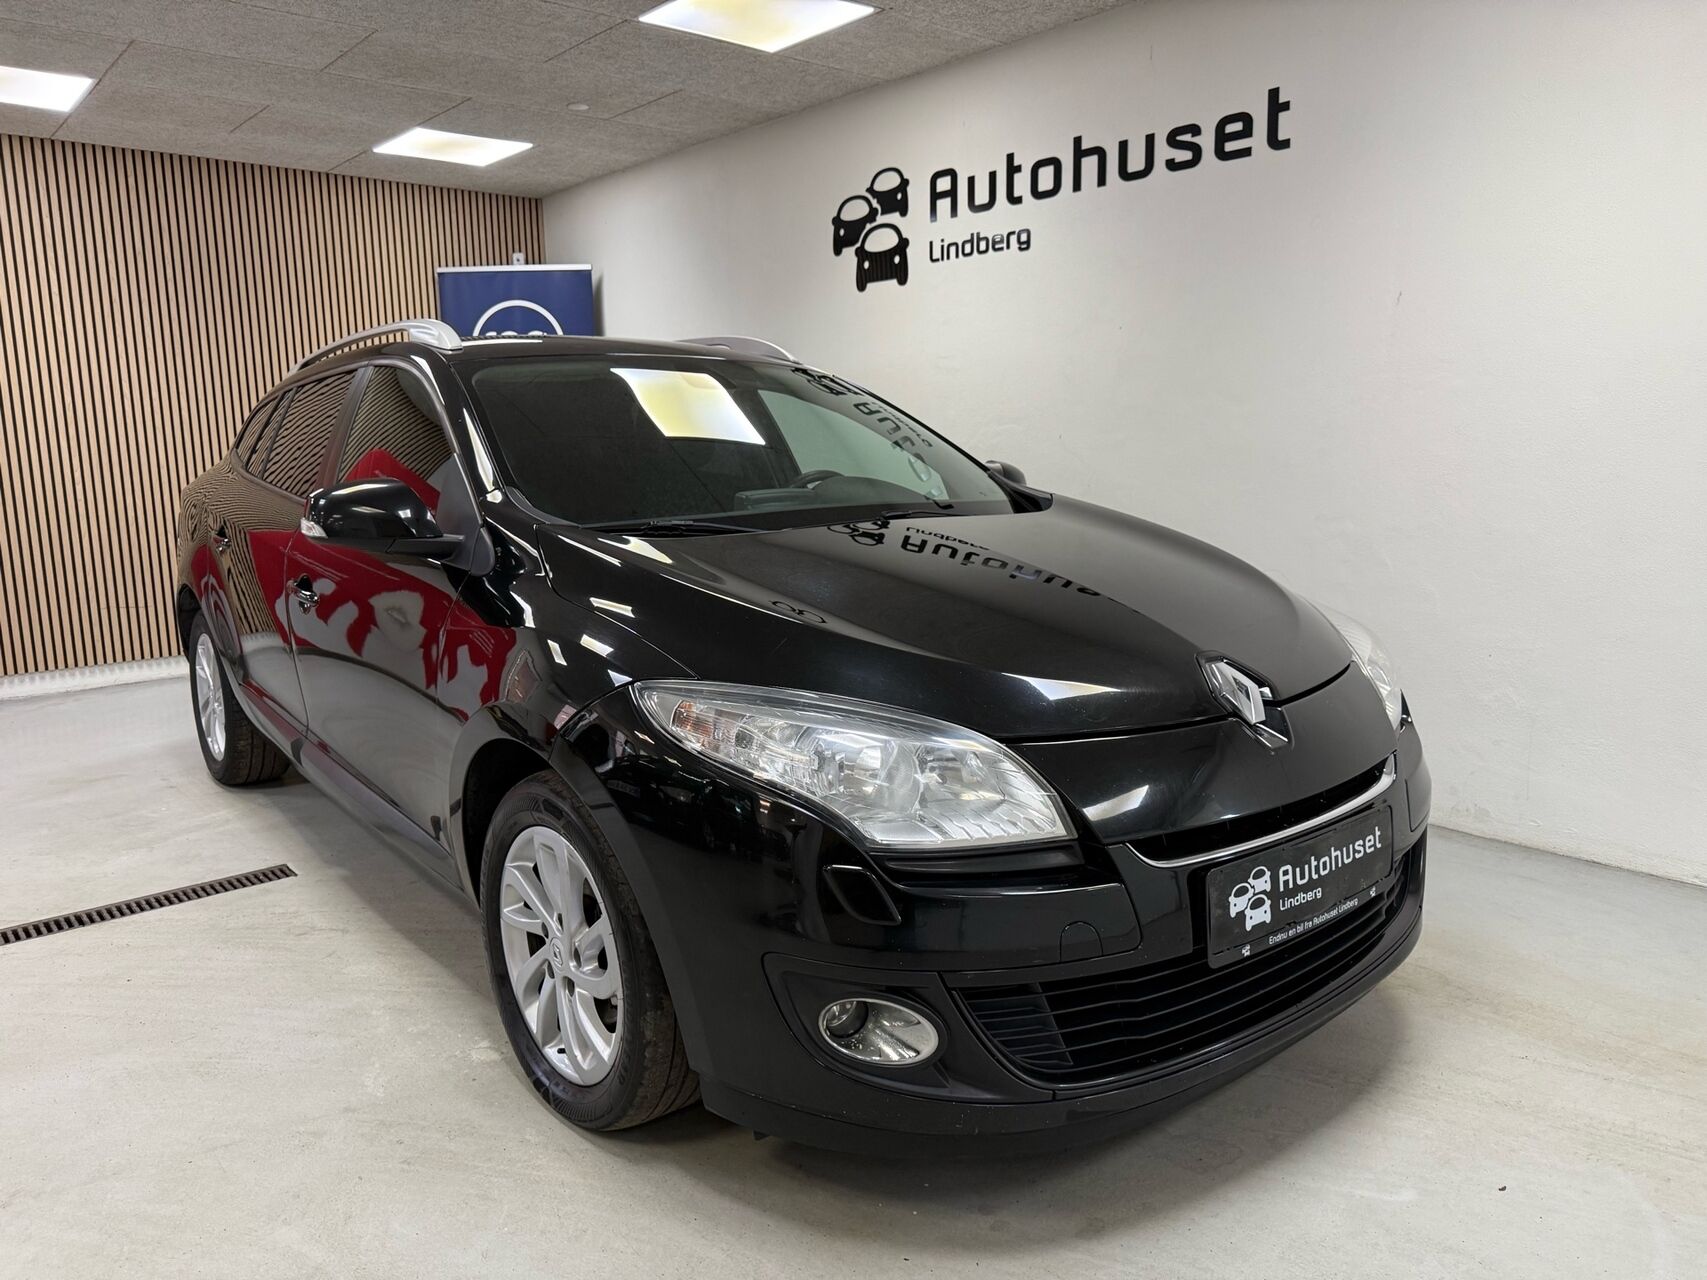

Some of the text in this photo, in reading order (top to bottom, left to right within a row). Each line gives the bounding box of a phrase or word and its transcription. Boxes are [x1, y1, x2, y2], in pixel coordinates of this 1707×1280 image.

[929, 86, 1291, 223] Autohuset
[929, 228, 1031, 263] Lindberg
[1279, 826, 1382, 892] Autohuset
[1269, 898, 1358, 945] Endnu en bil fra Autohuset Lindberg
[1279, 887, 1322, 911] Lindberg
